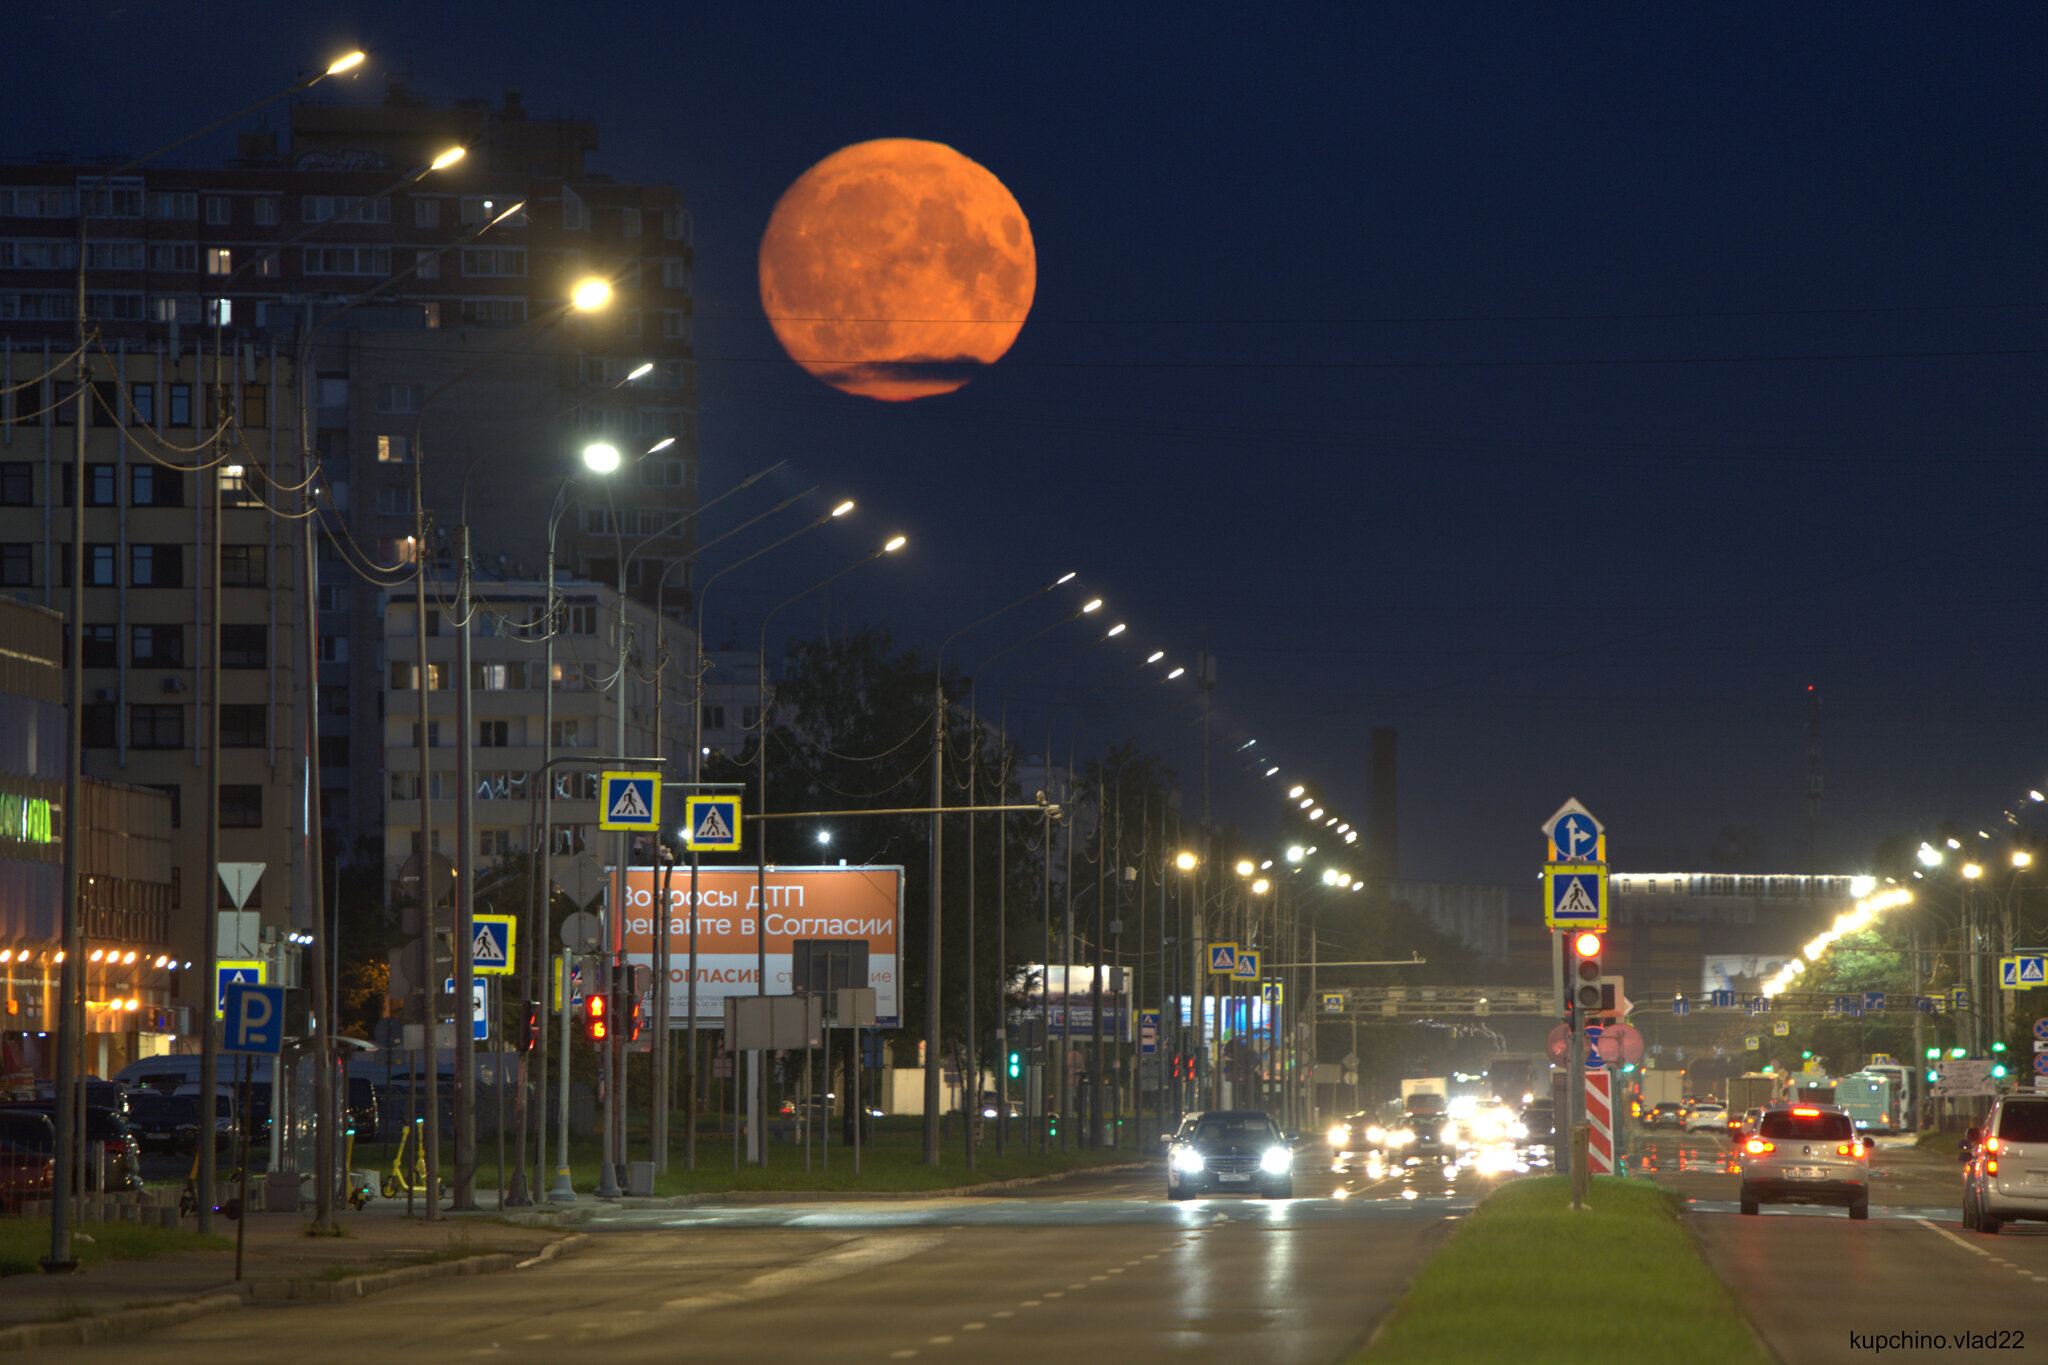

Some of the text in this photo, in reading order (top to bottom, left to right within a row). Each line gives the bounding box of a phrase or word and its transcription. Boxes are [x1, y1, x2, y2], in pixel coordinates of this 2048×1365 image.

[626, 885, 804, 912] Воросы ДТП
[625, 912, 893, 936] еайте в Согласии
[659, 968, 761, 984] ОГЛАСИЕ
